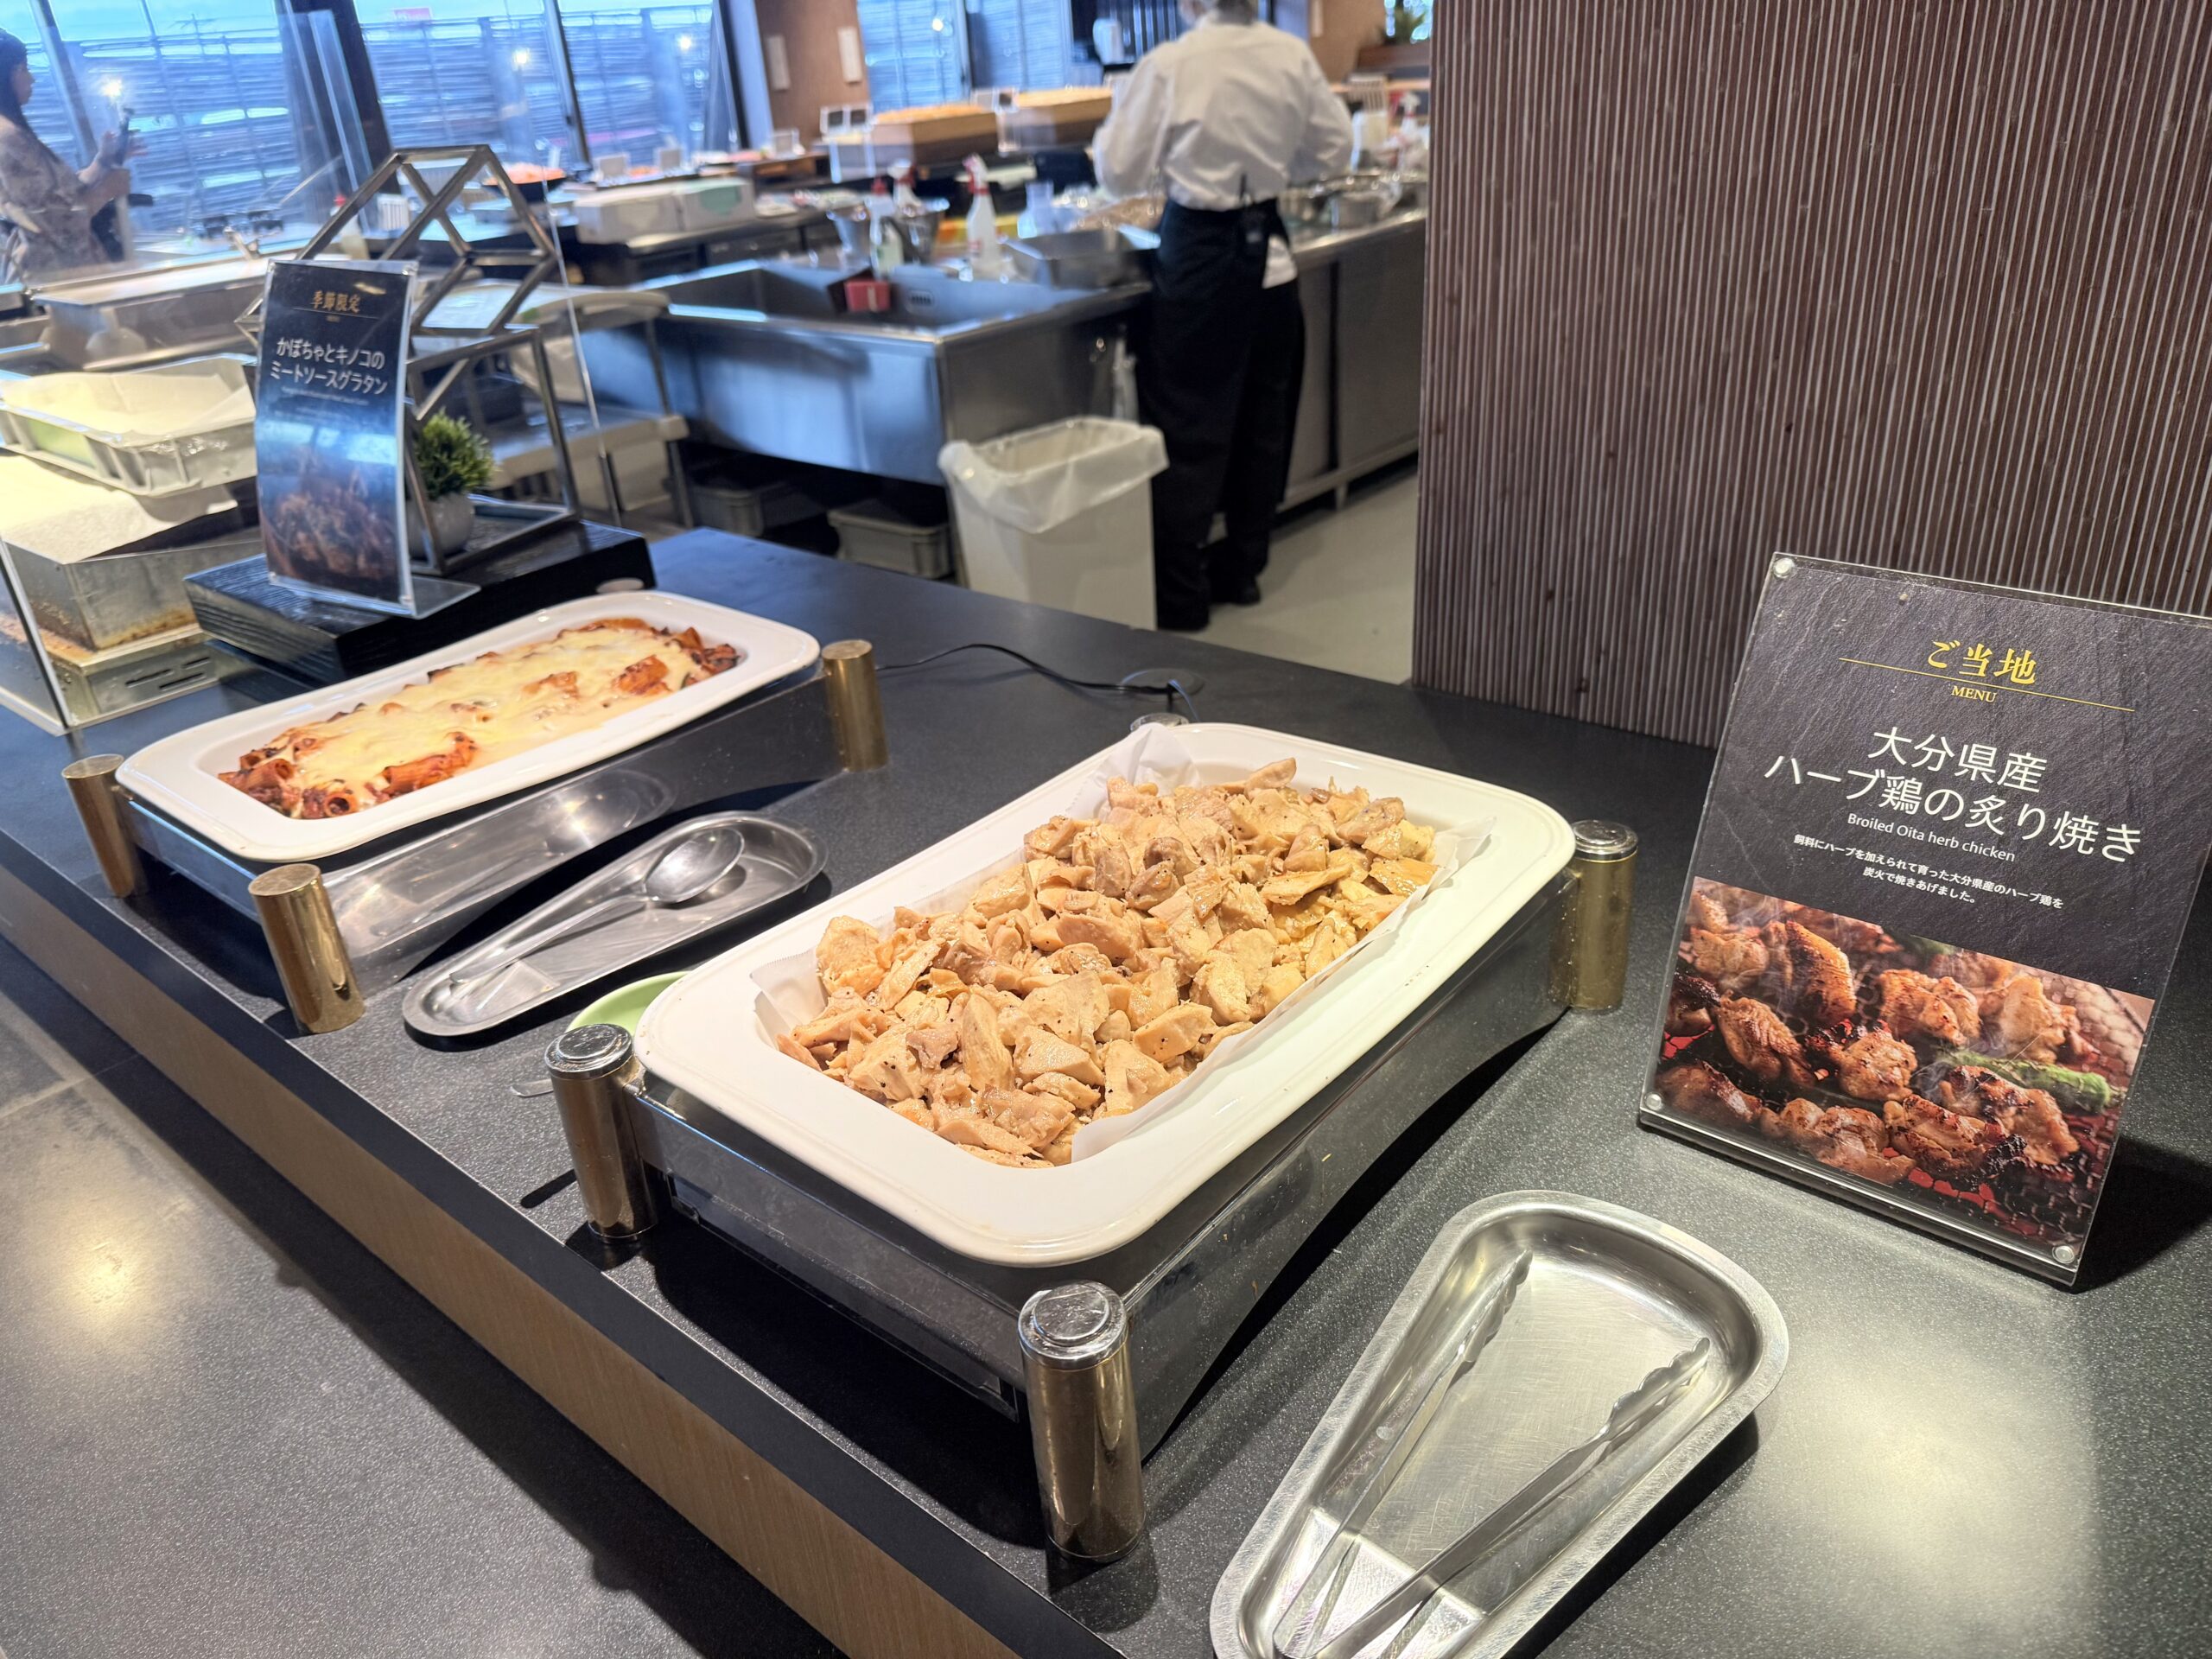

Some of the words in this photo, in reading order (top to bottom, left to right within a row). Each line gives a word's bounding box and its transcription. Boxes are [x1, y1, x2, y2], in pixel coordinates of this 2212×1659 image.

[276, 337, 385, 370] かぼちゃとキノコの
[270, 360, 388, 395] ミートソースグラタン
[1927, 640, 2037, 685] ご当地
[1951, 685, 1997, 702] MENU
[1867, 727, 2048, 793] 大分県産
[1764, 755, 2142, 863] ハーブ鶏の炙り焼き
[1847, 813, 1895, 835] Broiled
[1897, 824, 1926, 842] Oita
[1928, 830, 1960, 850] herb
[1961, 840, 2016, 862] chicken
[1862, 866, 1976, 905] 炭火で焼きあげました。
